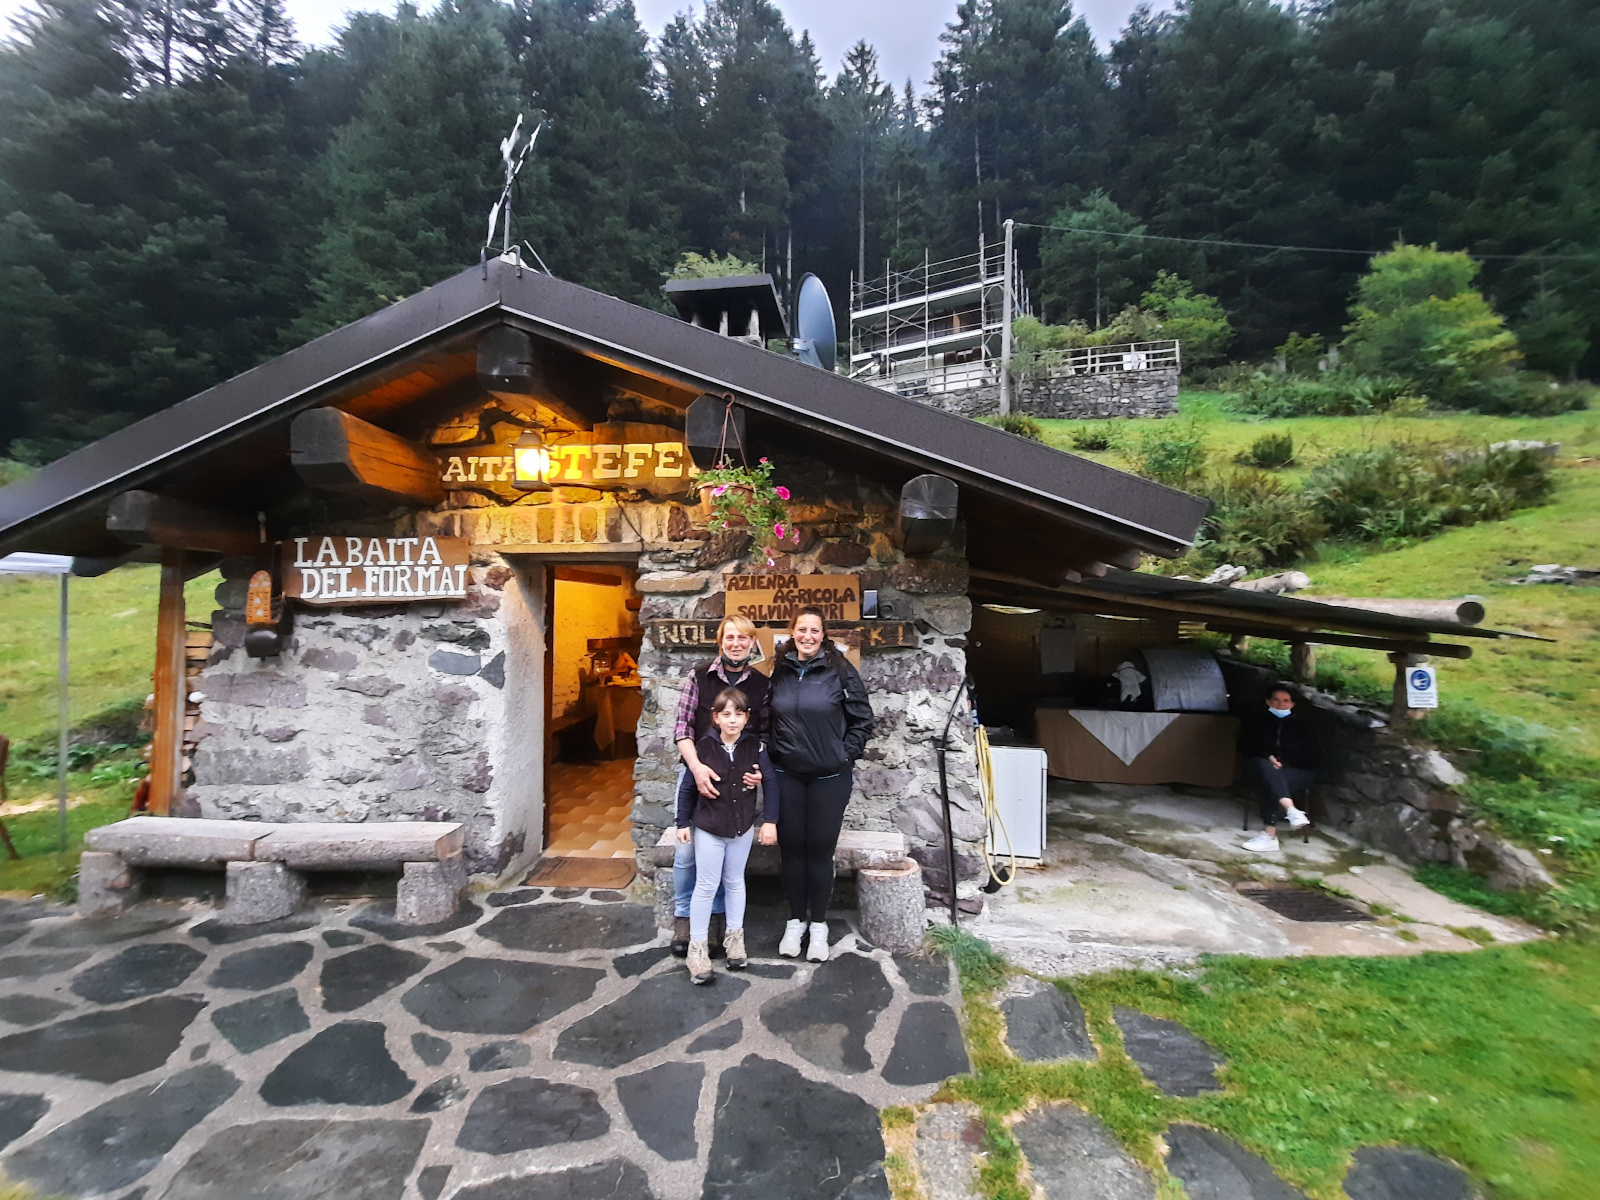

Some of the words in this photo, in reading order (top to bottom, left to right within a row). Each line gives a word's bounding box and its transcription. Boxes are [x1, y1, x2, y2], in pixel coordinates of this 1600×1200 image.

[438, 456, 515, 482] AITA
[294, 537, 342, 567] LA
[345, 537, 443, 566] BAITA
[300, 568, 358, 598] DEL
[361, 564, 468, 597] FORMAI
[727, 574, 799, 591] AZIENDA
[773, 588, 856, 603] AGRICOLA
